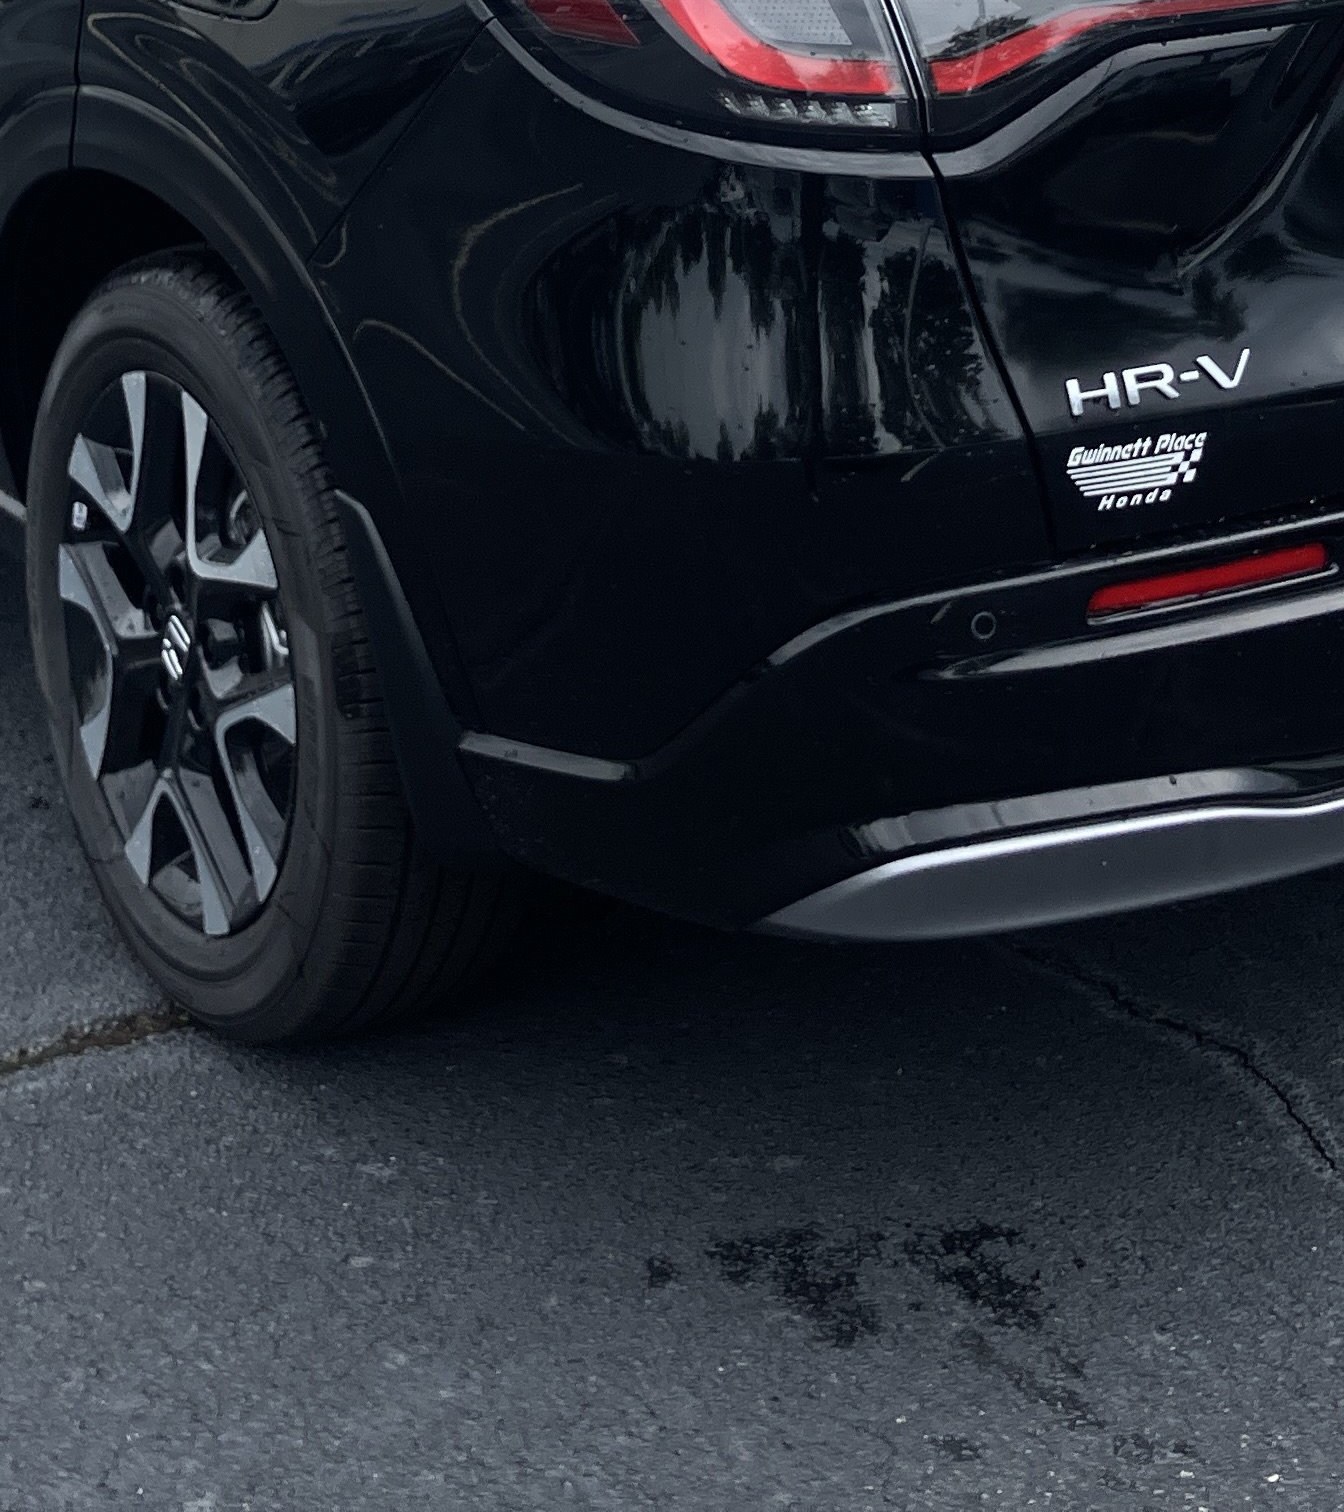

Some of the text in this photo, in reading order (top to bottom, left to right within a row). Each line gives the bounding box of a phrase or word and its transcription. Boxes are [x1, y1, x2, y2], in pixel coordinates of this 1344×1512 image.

[1065, 347, 1251, 417] HR-V
[1066, 431, 1208, 468] Gwinnett Place
[1097, 487, 1173, 512] Honda
